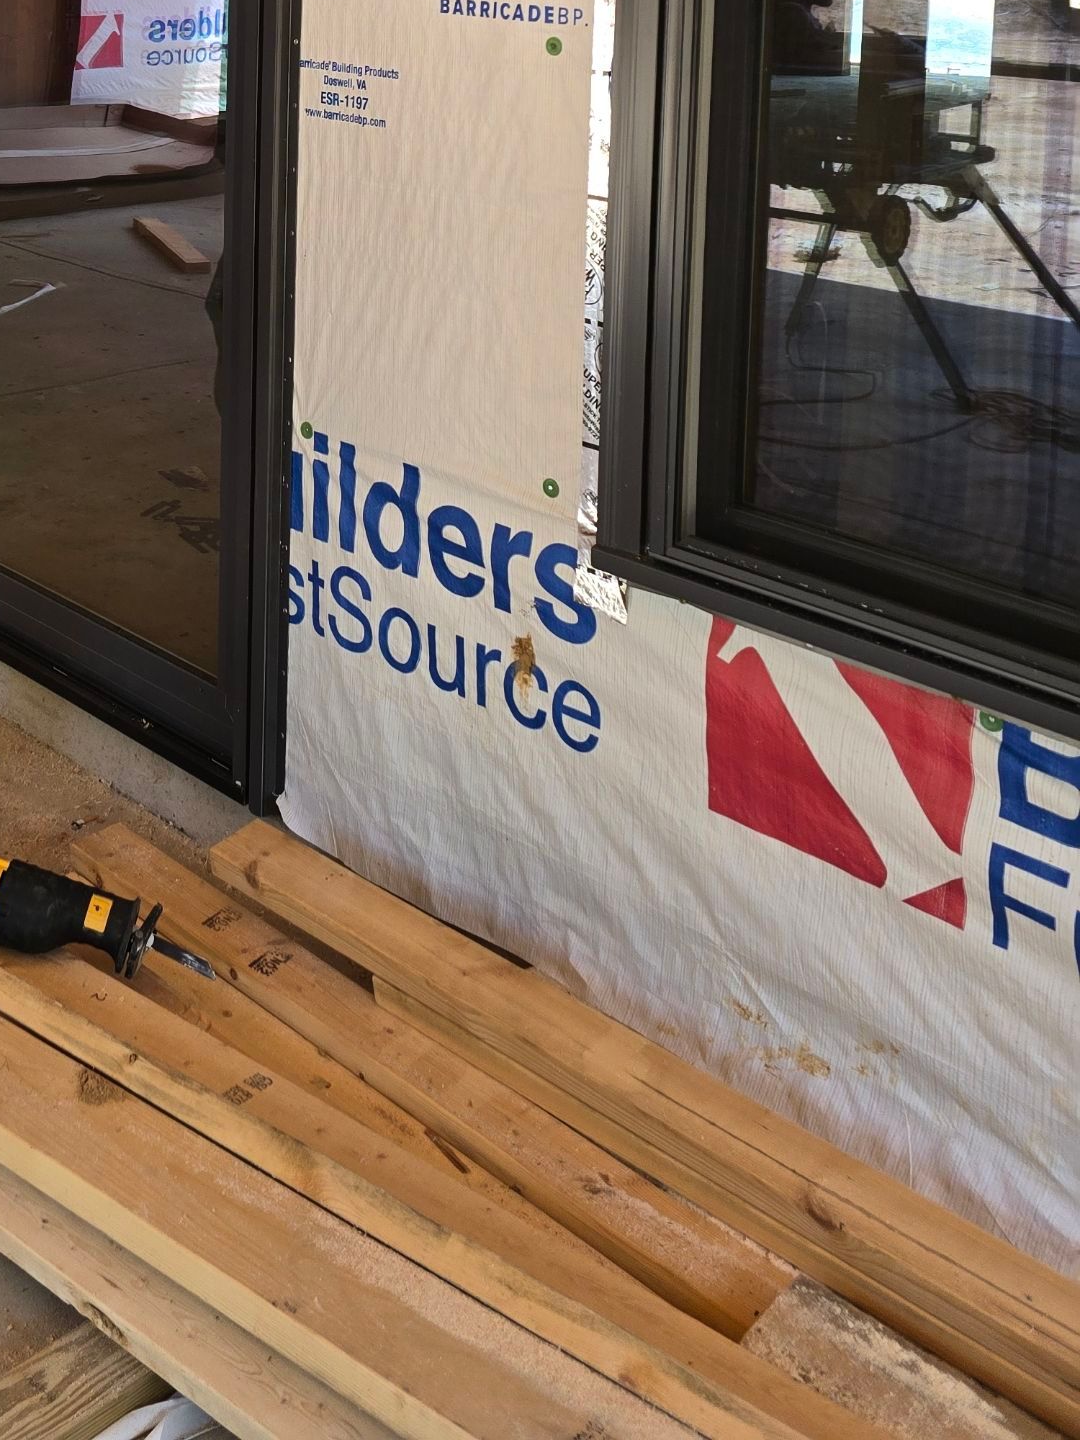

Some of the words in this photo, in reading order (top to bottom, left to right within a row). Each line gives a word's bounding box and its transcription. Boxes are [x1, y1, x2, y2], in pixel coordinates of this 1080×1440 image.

[332, 61, 363, 77] Building
[364, 64, 400, 80] Products
[323, 75, 355, 90] Doswell,
[356, 79, 367, 90] VA
[320, 91, 369, 111] ESR-1197
[304, 107, 387, 129] www.barricadebp.com
